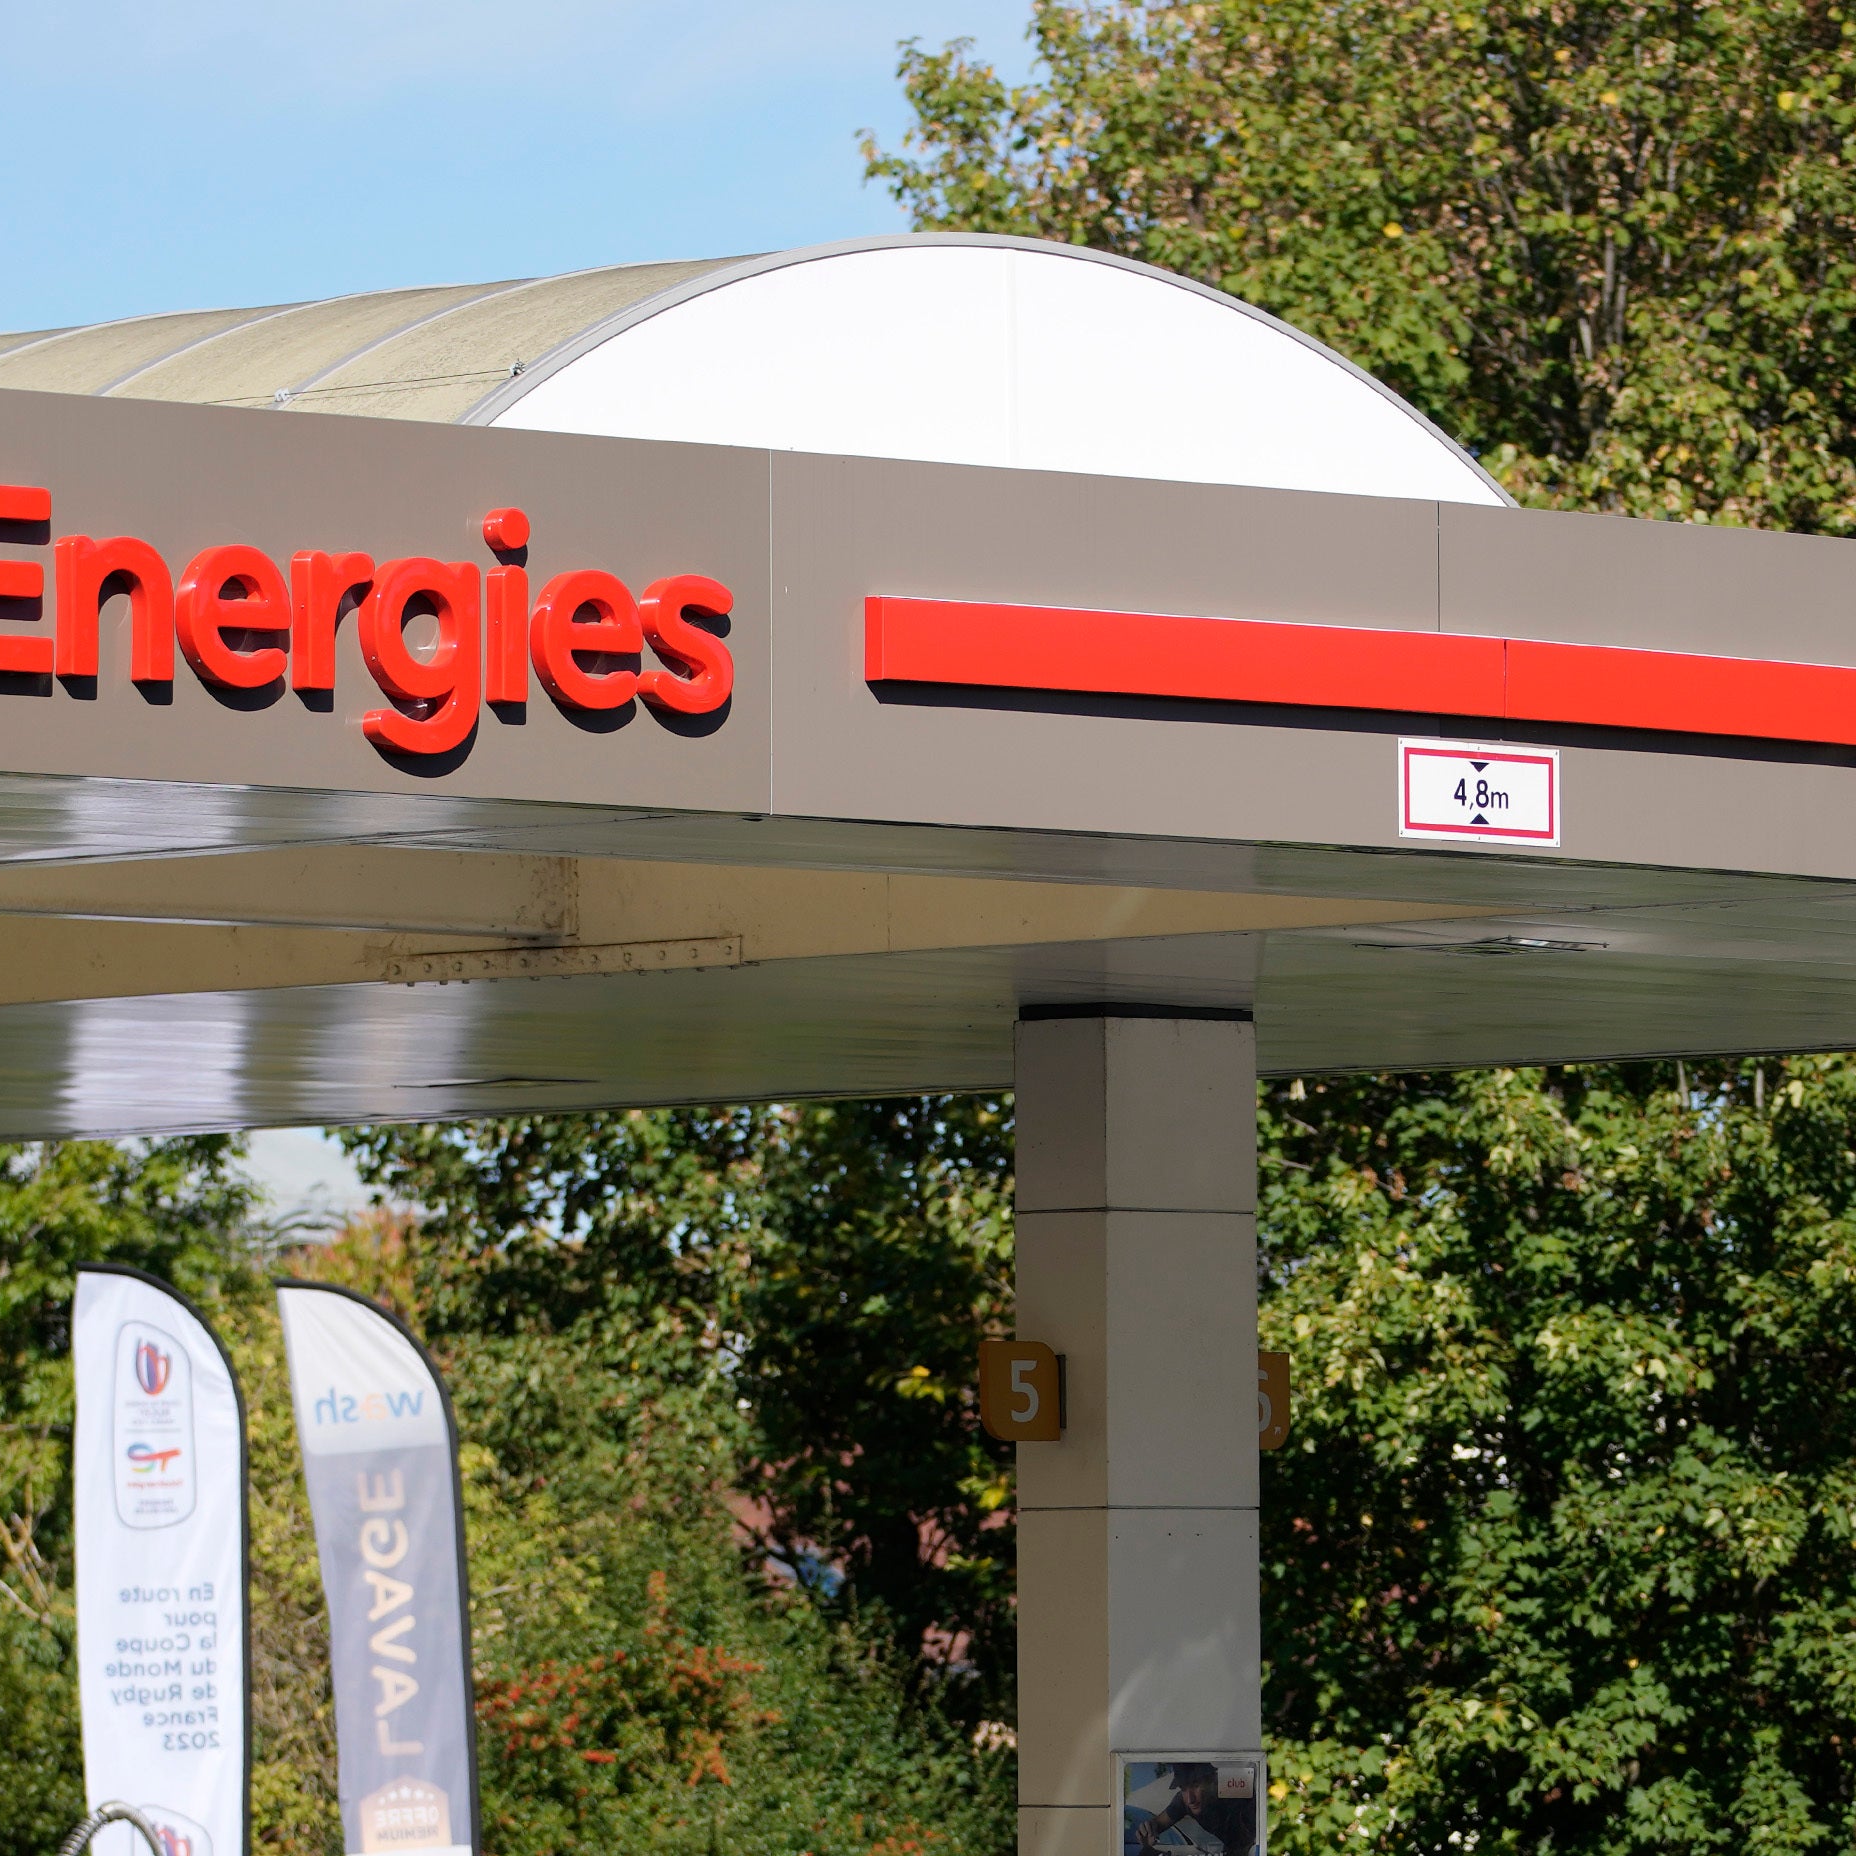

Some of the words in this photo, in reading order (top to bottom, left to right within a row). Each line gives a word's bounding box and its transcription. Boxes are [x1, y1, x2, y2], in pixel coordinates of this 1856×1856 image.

[1453, 777, 1509, 811] 4,8m
[1010, 1359, 1040, 1423] 5
[1227, 1778, 1246, 1788] club
